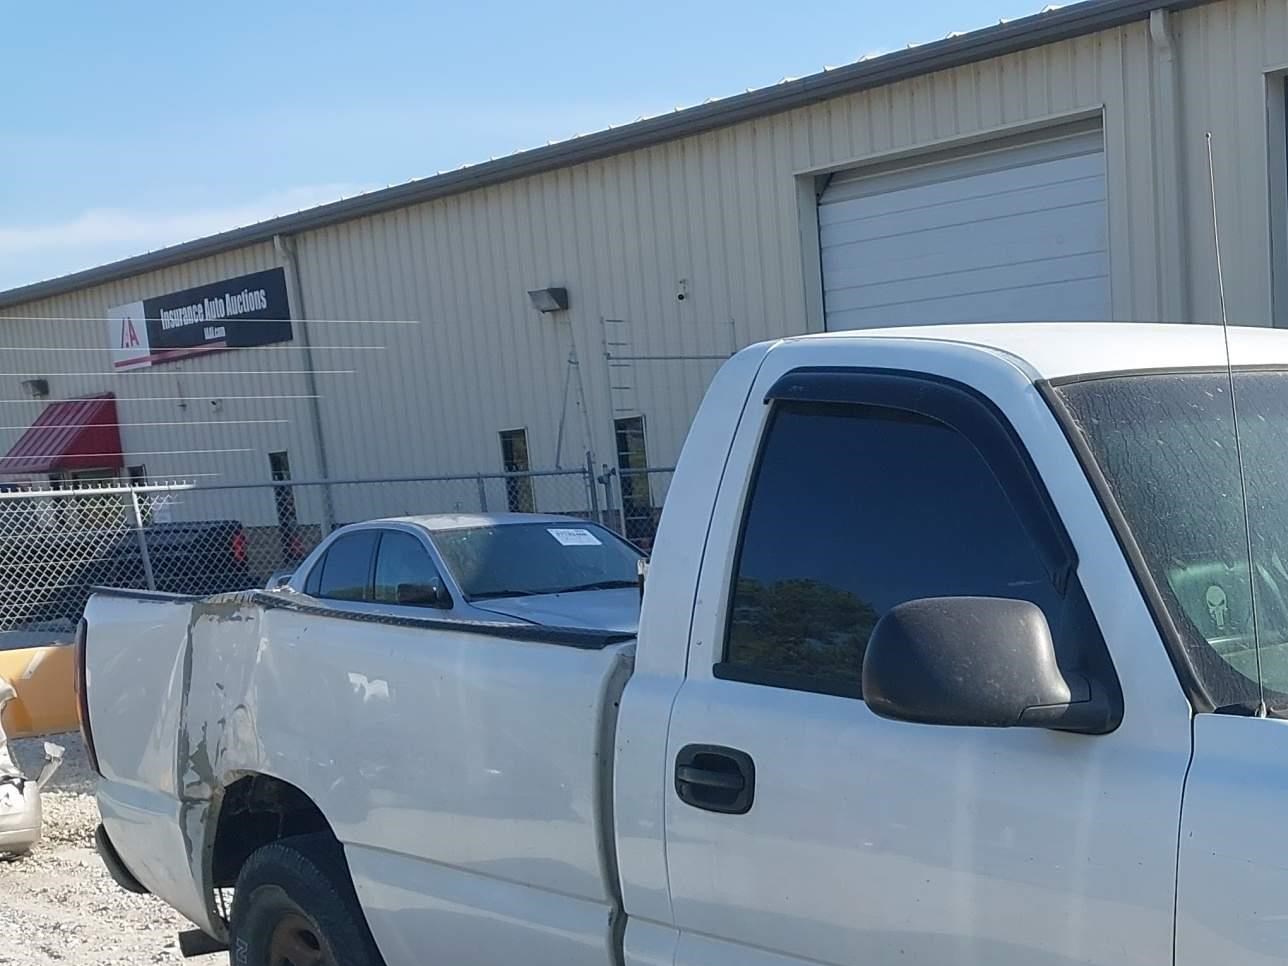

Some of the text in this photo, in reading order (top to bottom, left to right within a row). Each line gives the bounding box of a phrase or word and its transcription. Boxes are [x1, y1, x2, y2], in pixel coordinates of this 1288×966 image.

[160, 289, 267, 330] Insurance Auto Auctions
